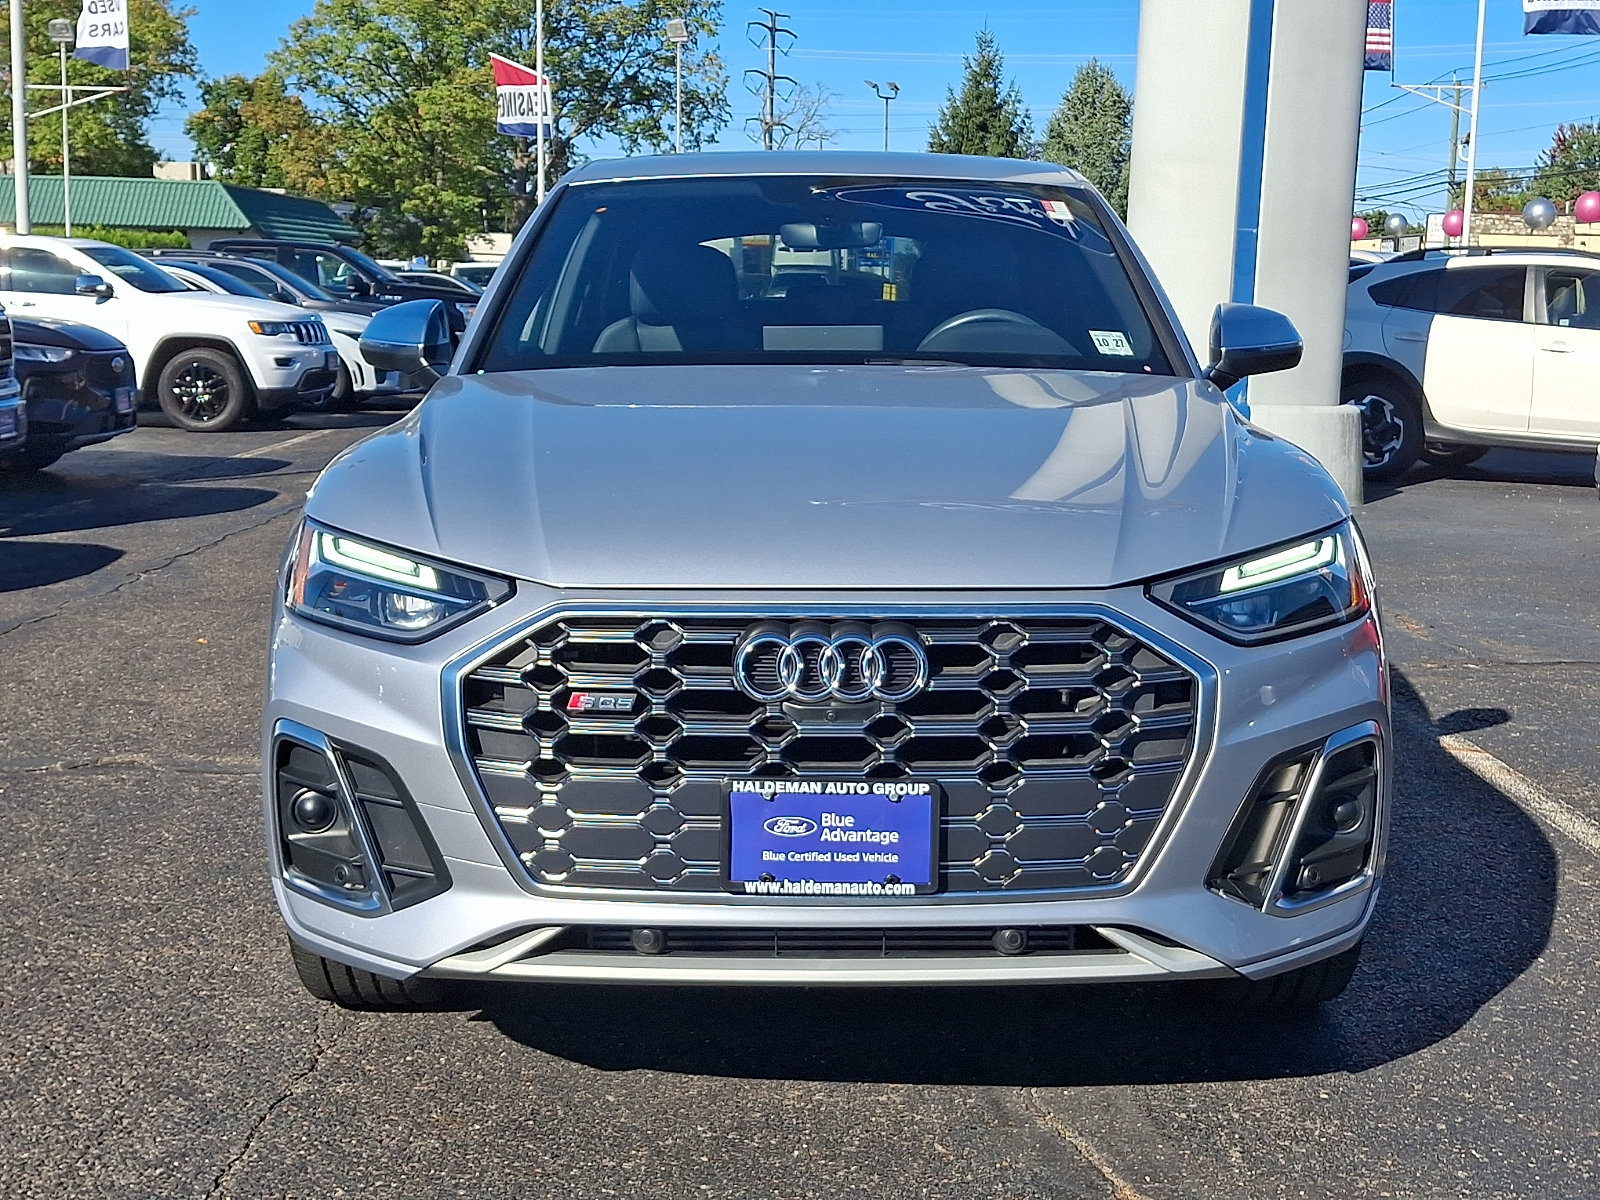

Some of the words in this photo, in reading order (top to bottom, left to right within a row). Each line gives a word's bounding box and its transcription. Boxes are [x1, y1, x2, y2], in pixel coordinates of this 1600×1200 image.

[1095, 337, 1109, 347] 10
[1113, 338, 1125, 347] 27
[576, 695, 634, 709] SQ5
[732, 780, 822, 794] HALDEMAN
[825, 782, 870, 795] AUTO
[872, 783, 930, 795] GROUP
[772, 818, 808, 833] Ford
[821, 812, 855, 827] Blue
[820, 828, 900, 845] Advantage
[762, 851, 786, 861] Blue
[787, 851, 831, 862] Certified
[833, 852, 860, 863] Used
[862, 852, 899, 863] Vehicle
[744, 878, 916, 895] www.haldemanauto.com
